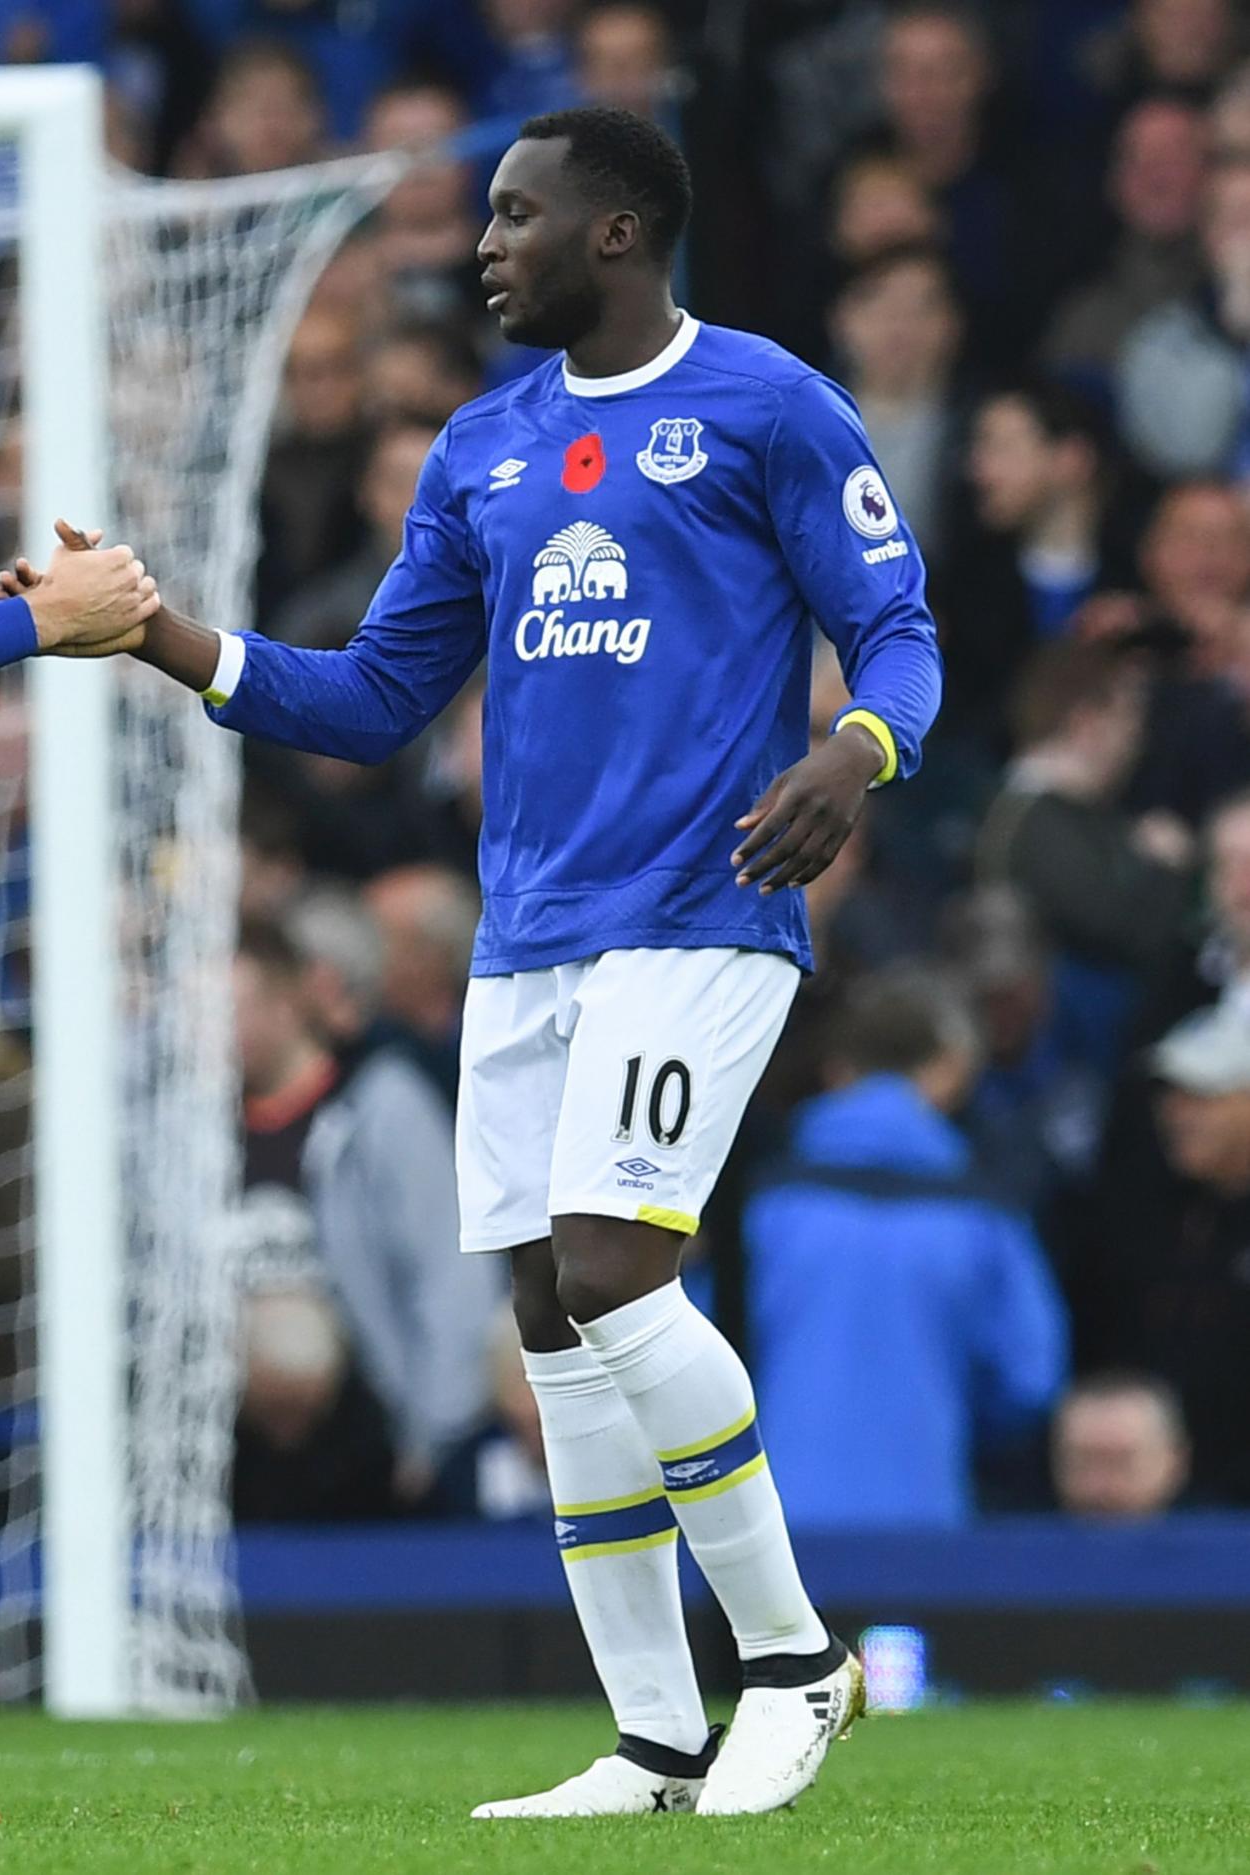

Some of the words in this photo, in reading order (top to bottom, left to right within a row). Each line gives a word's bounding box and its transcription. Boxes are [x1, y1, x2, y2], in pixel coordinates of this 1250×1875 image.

[515, 609, 652, 664] Chang
[615, 1055, 691, 1146] 10
[617, 1177, 654, 1191] umbro
